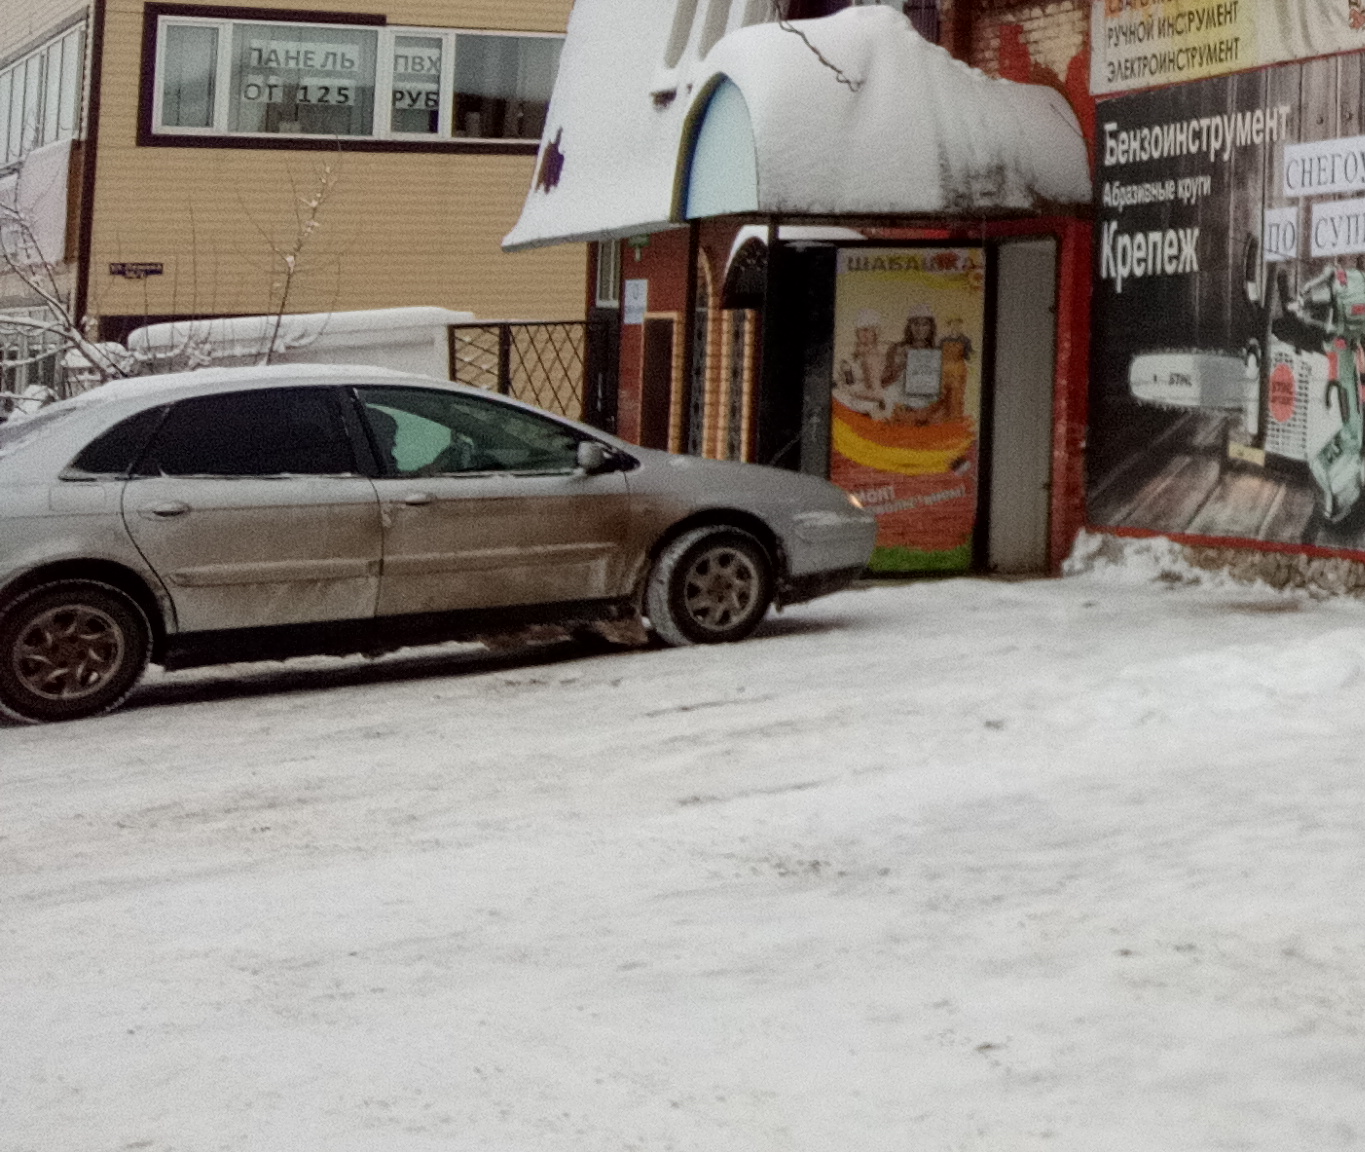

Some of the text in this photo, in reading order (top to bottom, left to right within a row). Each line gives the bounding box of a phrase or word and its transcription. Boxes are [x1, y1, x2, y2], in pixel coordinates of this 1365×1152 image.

[1107, 19, 1155, 48] РУЧНОЙ
[249, 48, 441, 73] ПАНЕЛЬ ПВХ
[1106, 37, 1241, 83] ЭЛЕКТРОИНСТРУМЕНТ
[243, 82, 440, 109] ОТ 125 РУБ
[1103, 105, 1292, 167] Бензоинструмент
[1102, 174, 1212, 212] Абразивные круги
[1267, 220, 1297, 254] ПО
[1101, 220, 1200, 294] Крепеж
